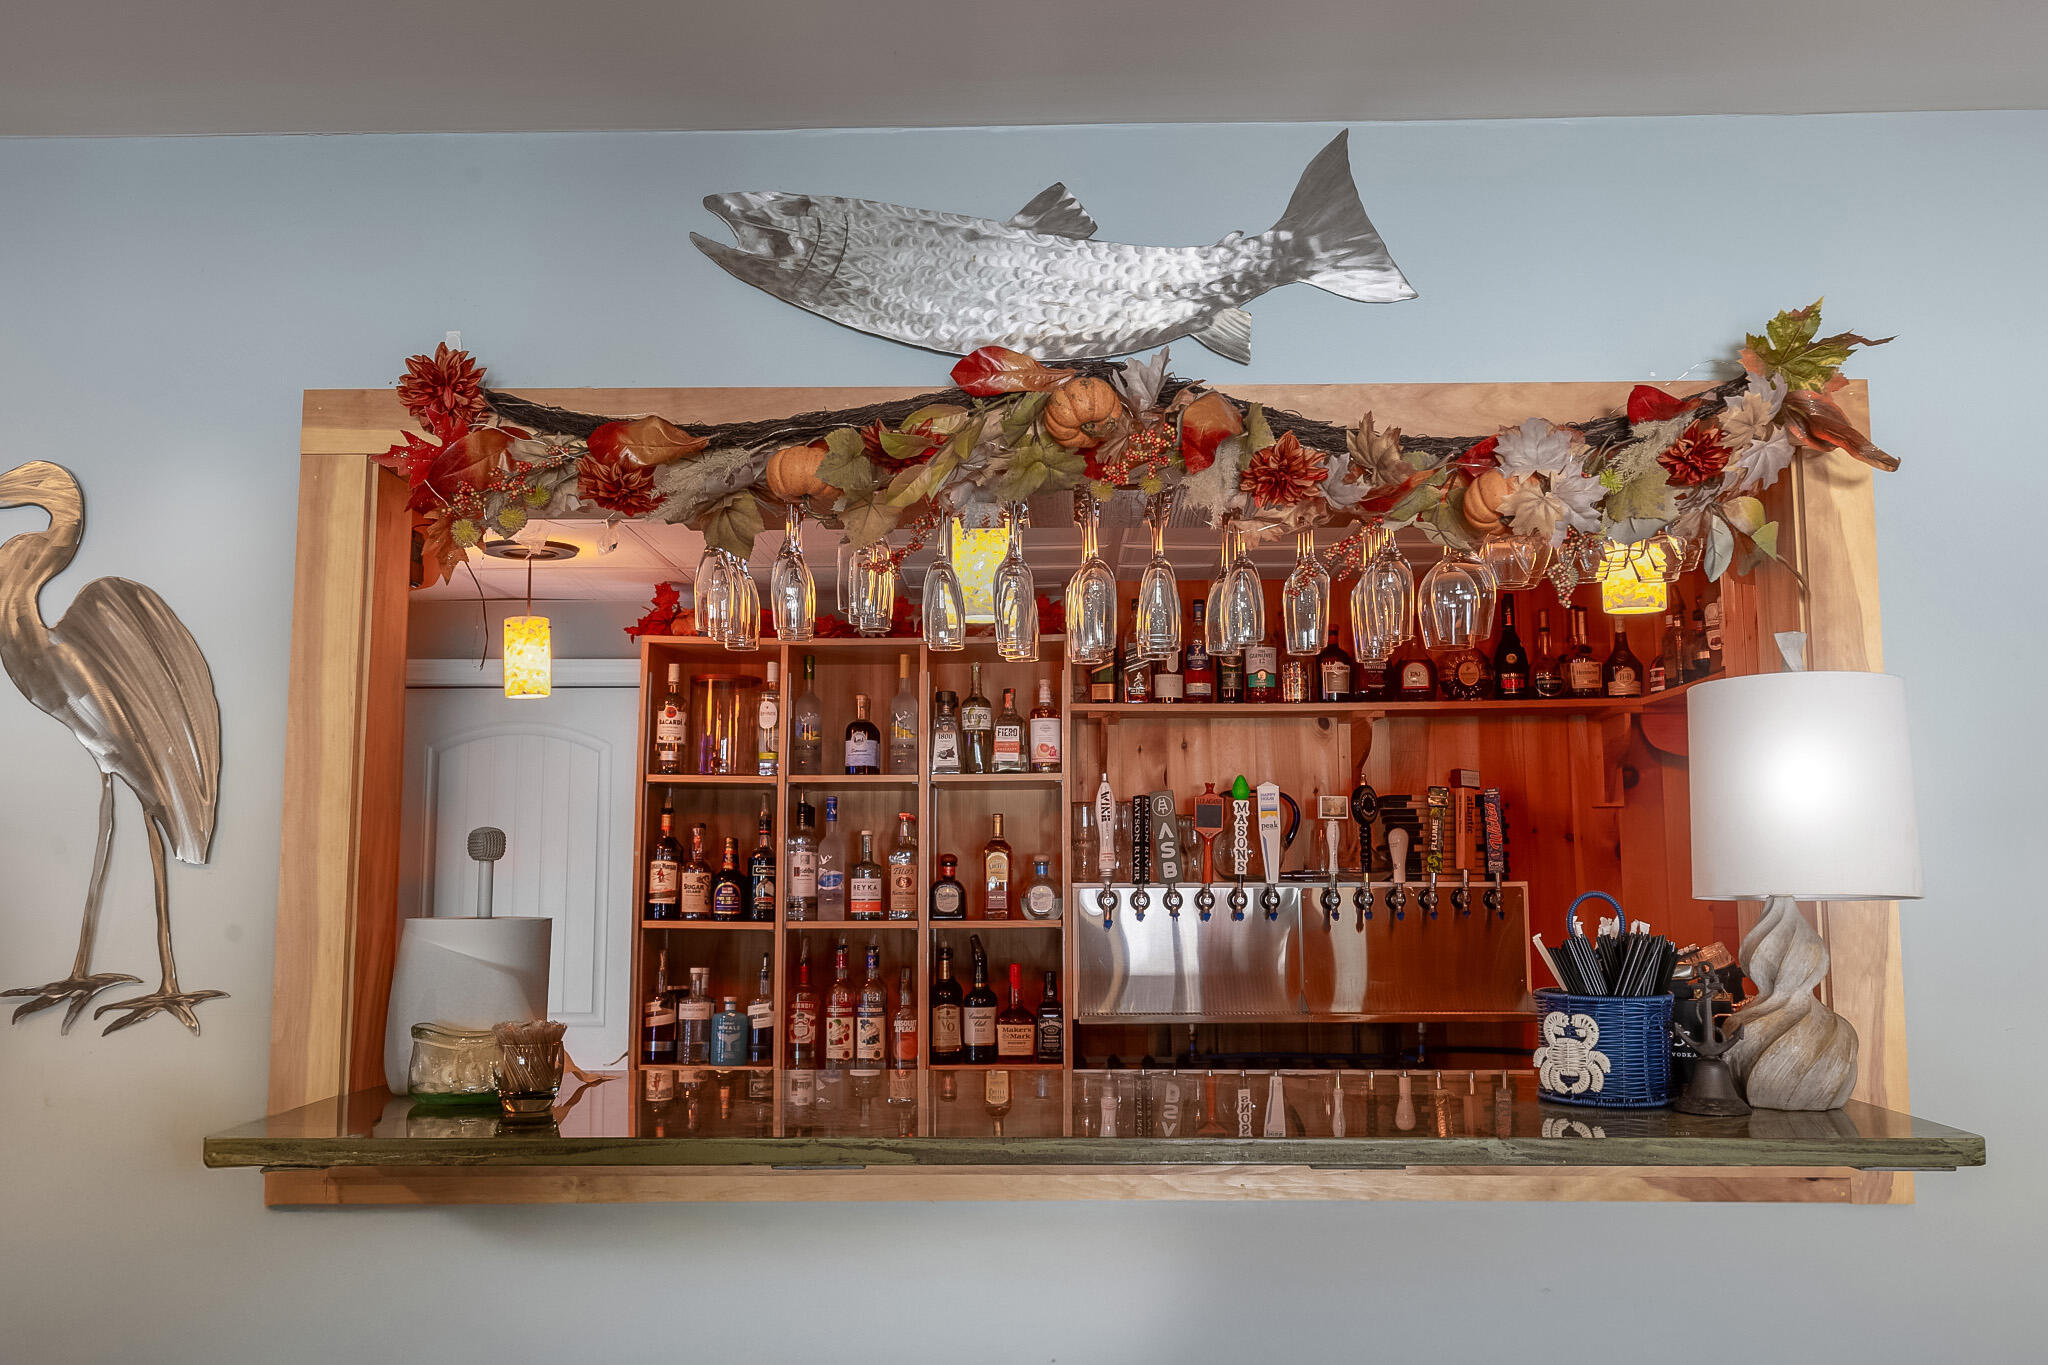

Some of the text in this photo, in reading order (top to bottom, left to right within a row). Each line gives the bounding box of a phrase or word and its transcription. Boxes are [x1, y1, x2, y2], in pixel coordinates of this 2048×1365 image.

[938, 733, 954, 741] 1800
[997, 728, 1018, 737] FIERO
[1100, 791, 1111, 822] WINE
[1235, 802, 1248, 872] MASONS
[1261, 821, 1278, 832] peak
[1431, 819, 1439, 850] FLUME
[1134, 798, 1142, 881] BATSON RIVER
[894, 1019, 917, 1027] ABSOLUT
